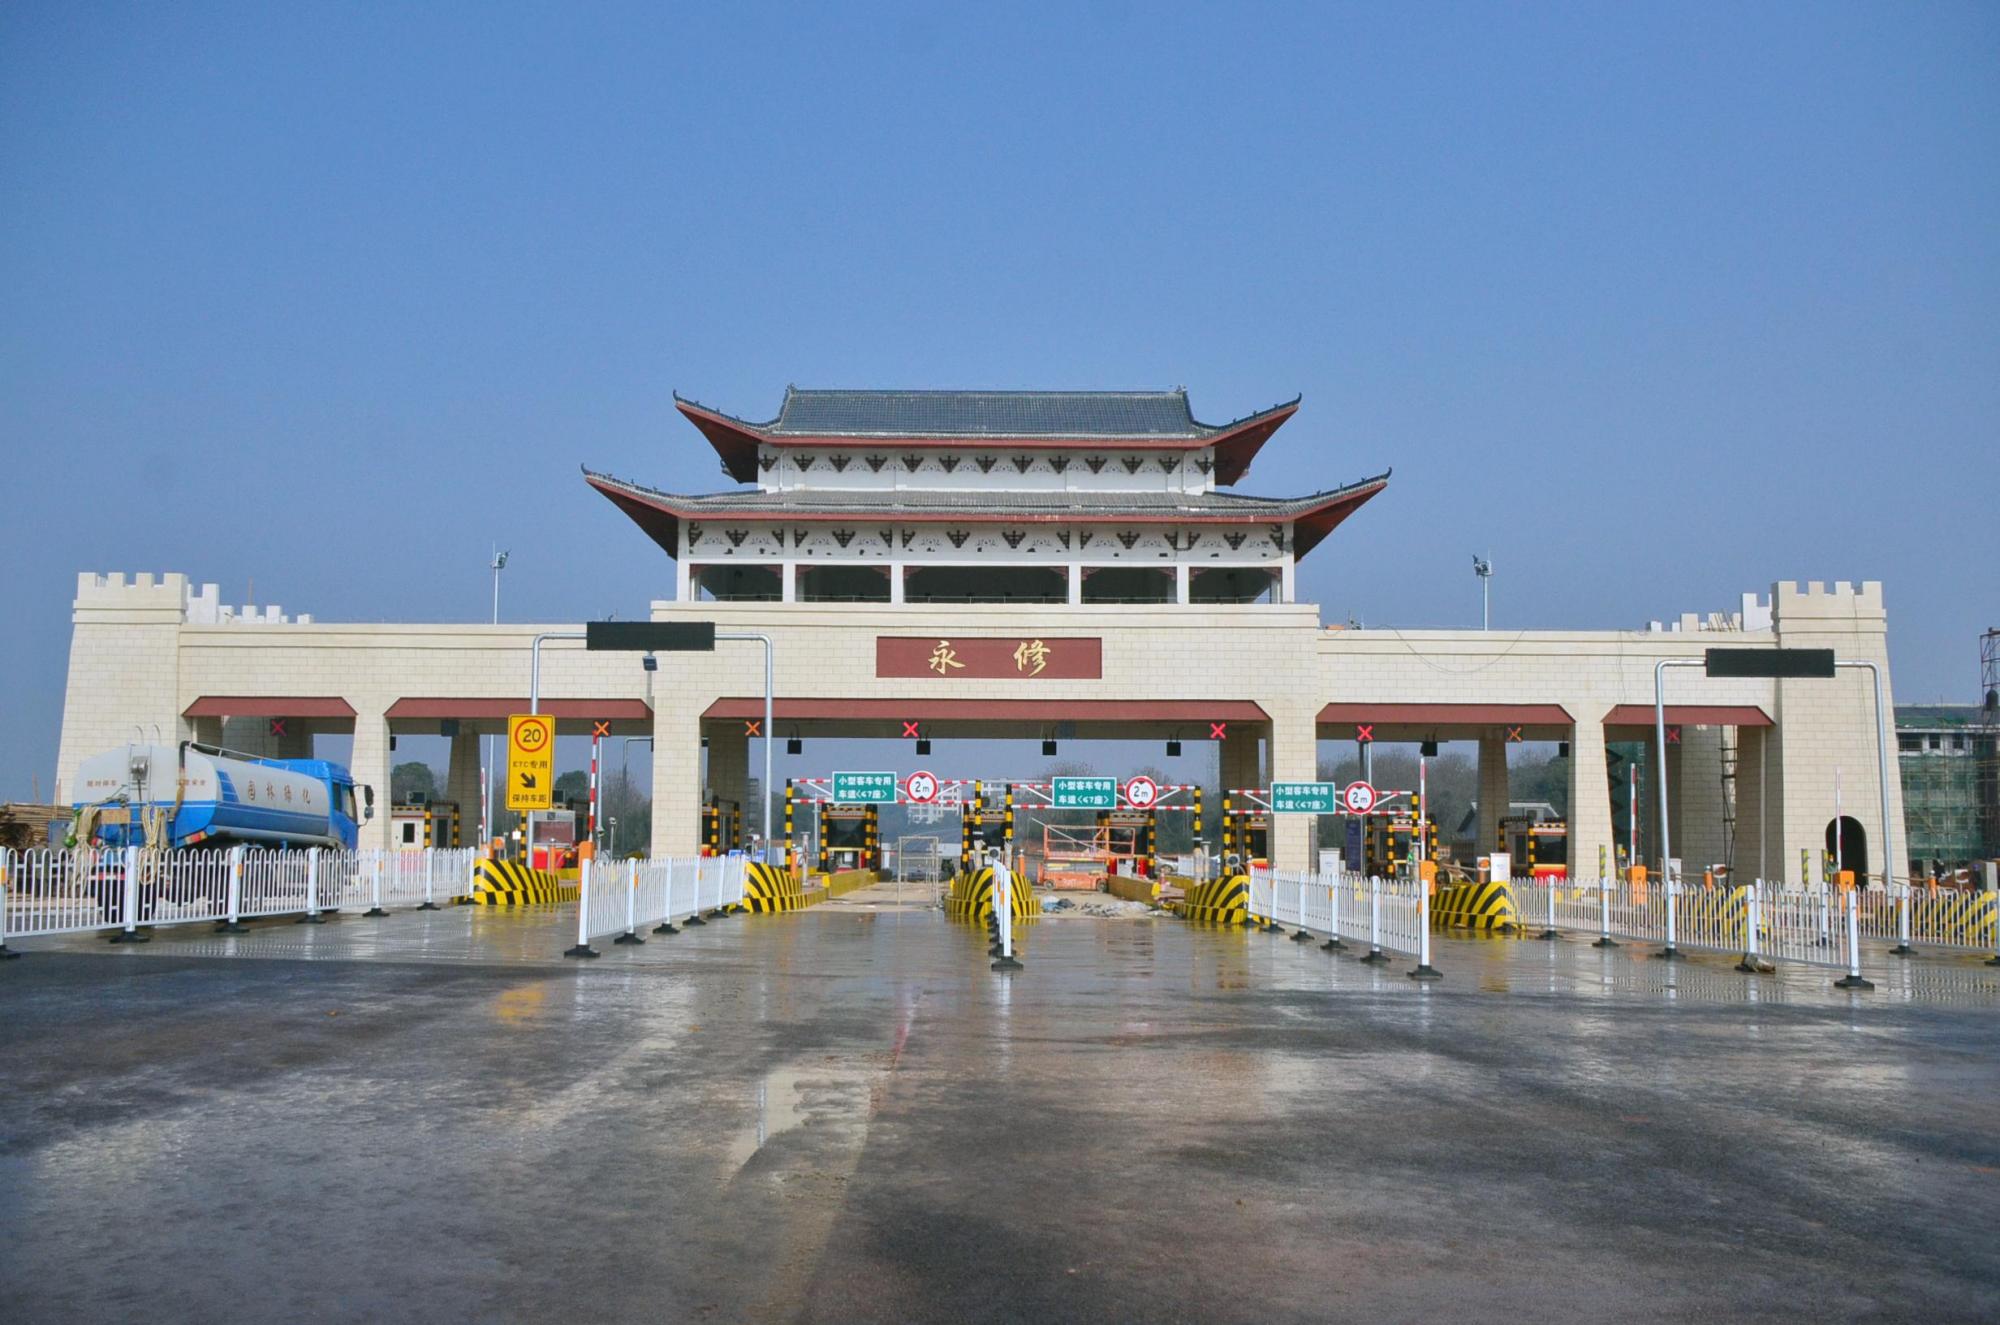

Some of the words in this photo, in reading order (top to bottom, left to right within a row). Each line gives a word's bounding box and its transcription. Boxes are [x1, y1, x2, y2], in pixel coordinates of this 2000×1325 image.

[928, 639, 1051, 677] 永修
[523, 729, 541, 743] 20
[838, 775, 892, 786] 小型客车专用
[1058, 780, 1111, 791] 小型客车专用
[1275, 785, 1328, 796] 小型客车专用
[512, 793, 547, 803] 保持车距
